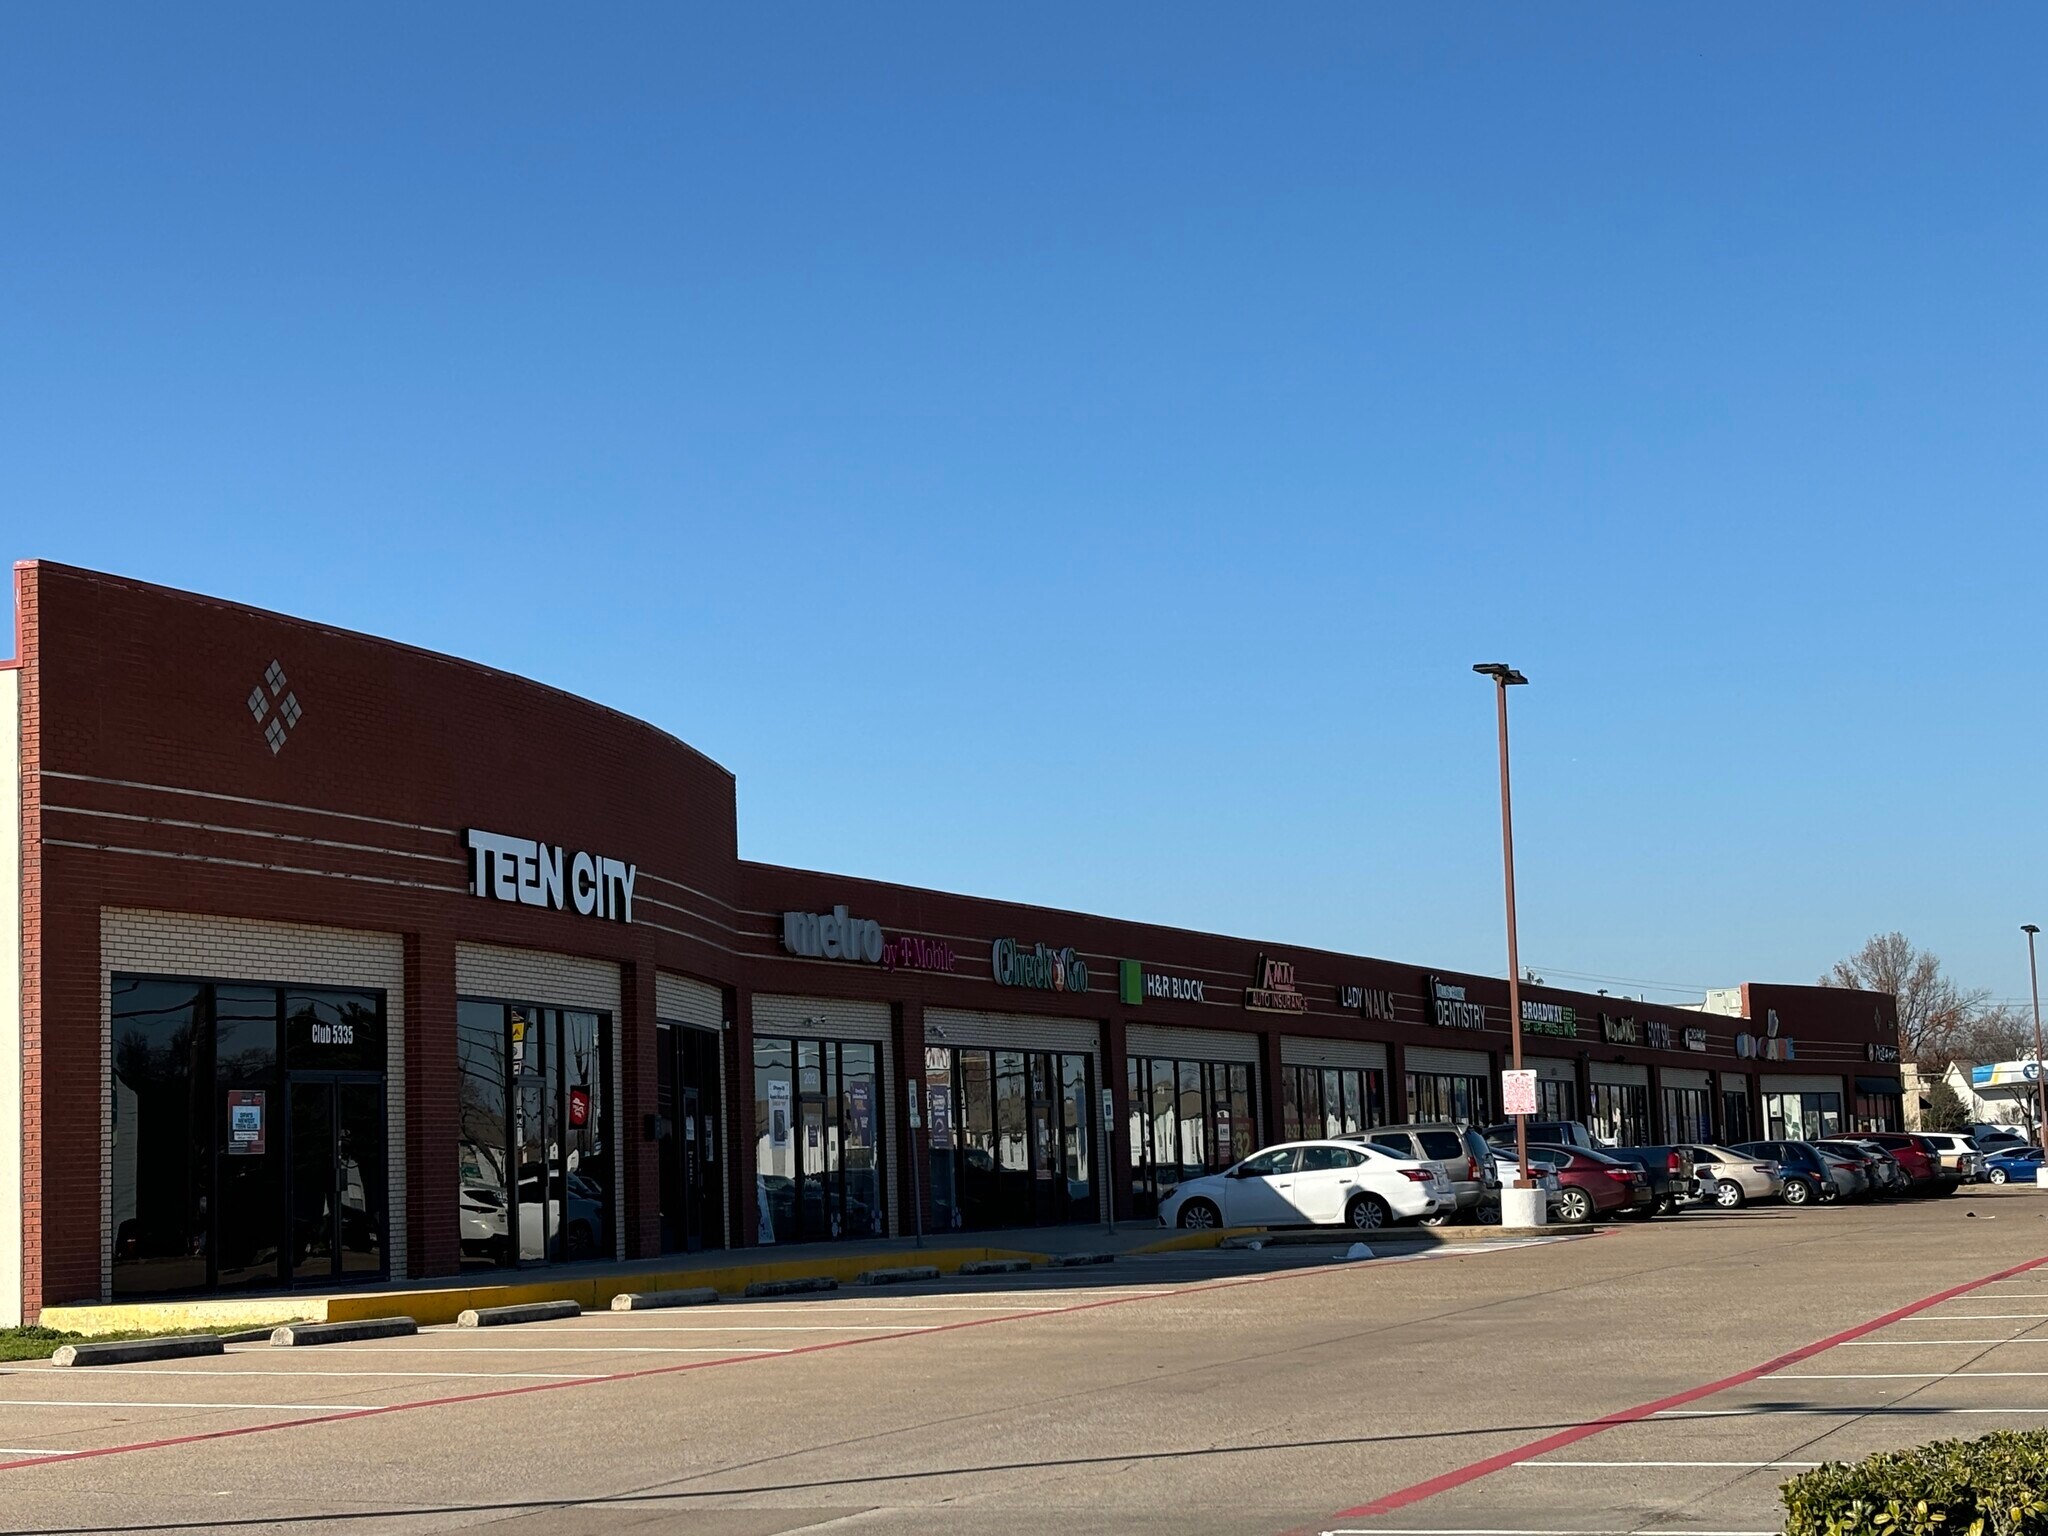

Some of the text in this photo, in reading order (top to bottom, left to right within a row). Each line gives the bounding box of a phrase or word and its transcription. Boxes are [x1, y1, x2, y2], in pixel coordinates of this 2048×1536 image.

[468, 828, 637, 923] TEEN CITY
[783, 904, 883, 963] metro
[1147, 973, 1204, 1002] H&R BLOCK
[1252, 991, 1270, 1007] AUTO
[1341, 985, 1395, 1020] LADY NAILS
[1436, 999, 1486, 1030] DENTISTRY
[1521, 1000, 1563, 1023] BROADWAY
[312, 1023, 353, 1045] Club 5335
